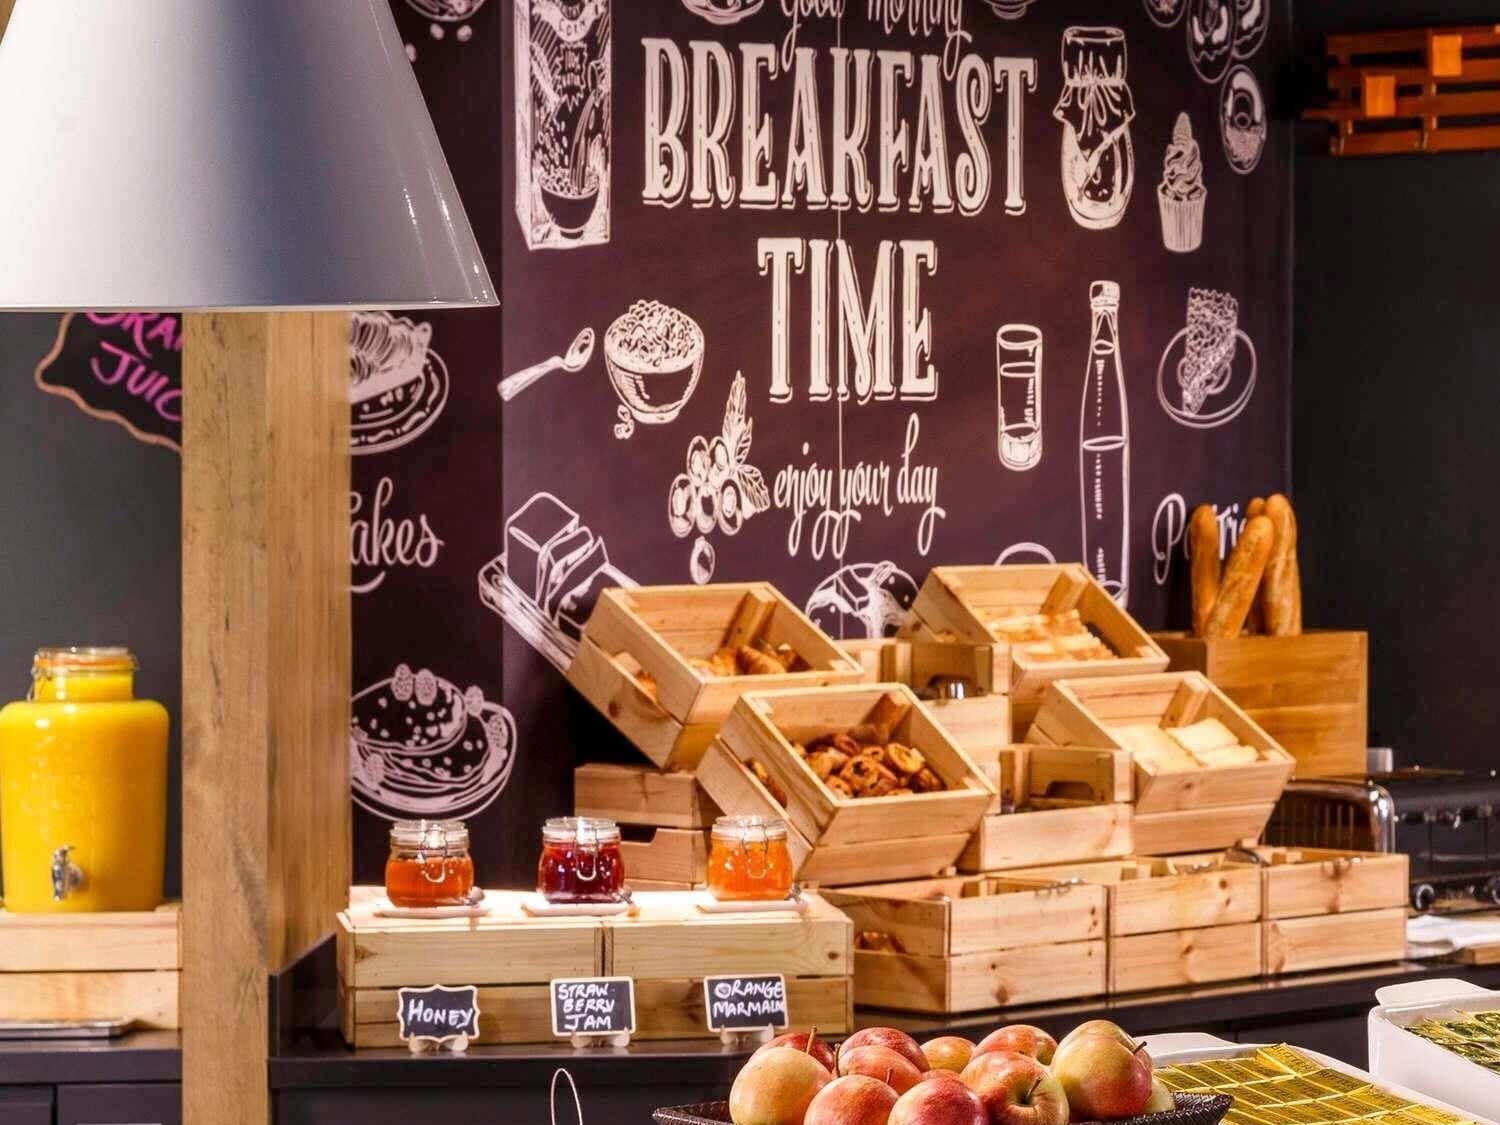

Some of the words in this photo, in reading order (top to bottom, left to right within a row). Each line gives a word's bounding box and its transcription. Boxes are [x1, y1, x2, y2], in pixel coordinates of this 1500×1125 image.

[641, 38, 1037, 216] BREAKFAST
[757, 237, 939, 405] TIME
[91, 340, 182, 421] JUIC
[774, 442, 841, 560] enjoy
[832, 461, 893, 559] your
[897, 412, 946, 556] day
[407, 999, 473, 1029] HONEY
[563, 998, 615, 1014] BERRY
[714, 980, 783, 999] ORANGE
[564, 1013, 612, 1031] JAM
